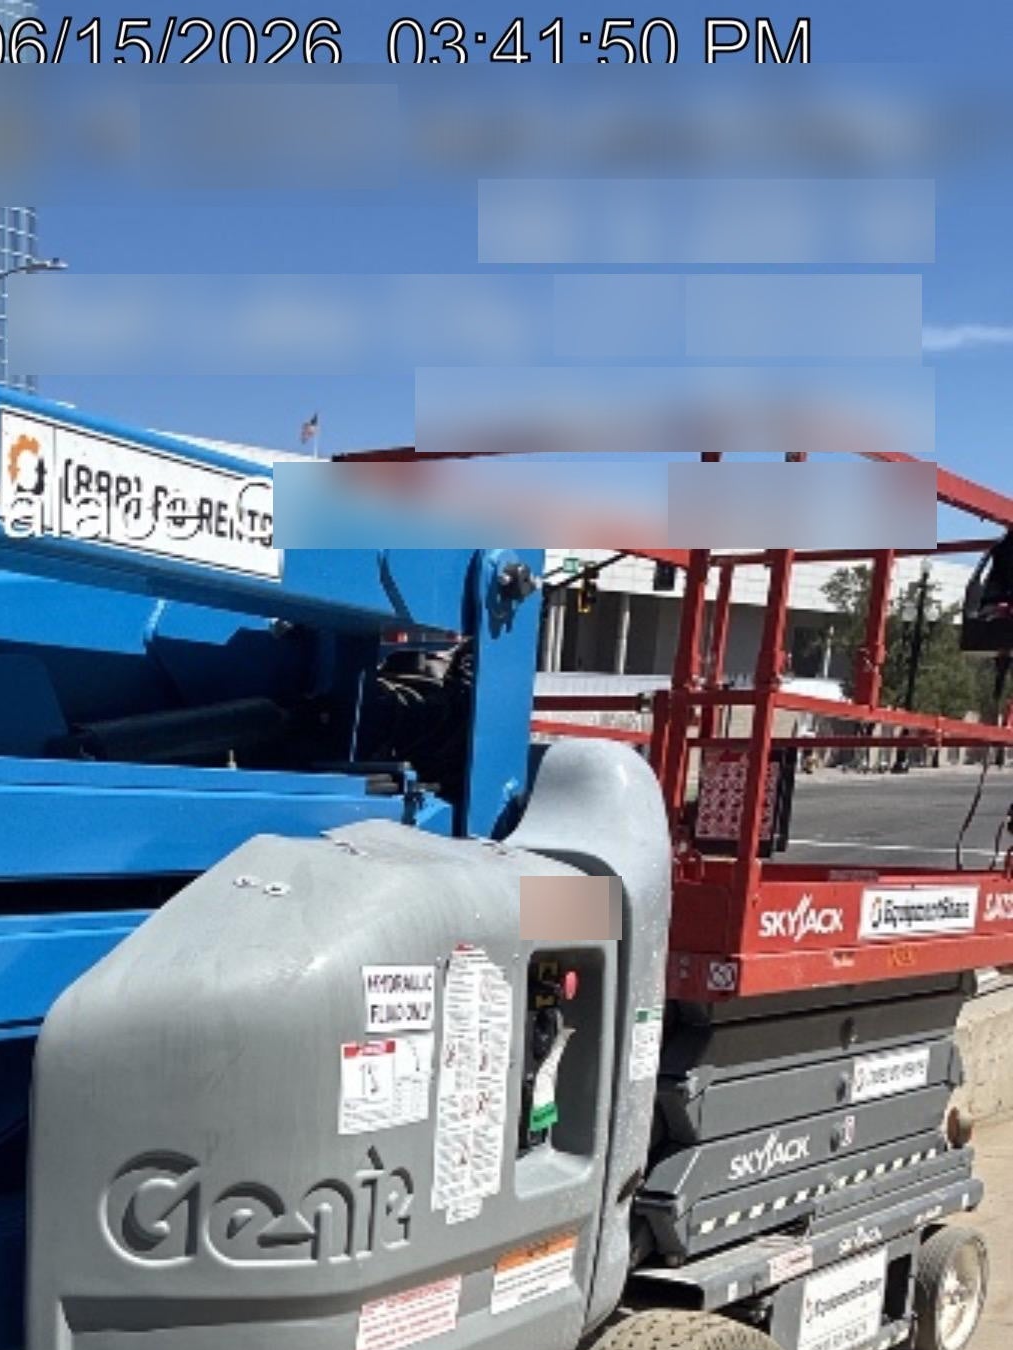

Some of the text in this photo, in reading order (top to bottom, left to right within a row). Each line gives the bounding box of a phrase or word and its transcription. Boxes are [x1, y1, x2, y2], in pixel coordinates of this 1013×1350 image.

[758, 893, 844, 943] SKYJACK
[367, 972, 433, 994] HYDRAULIC
[370, 1001, 432, 1024] FLUID ONLY
[728, 1130, 811, 1181] SKYJACK
[98, 1146, 417, 1268] Genie
